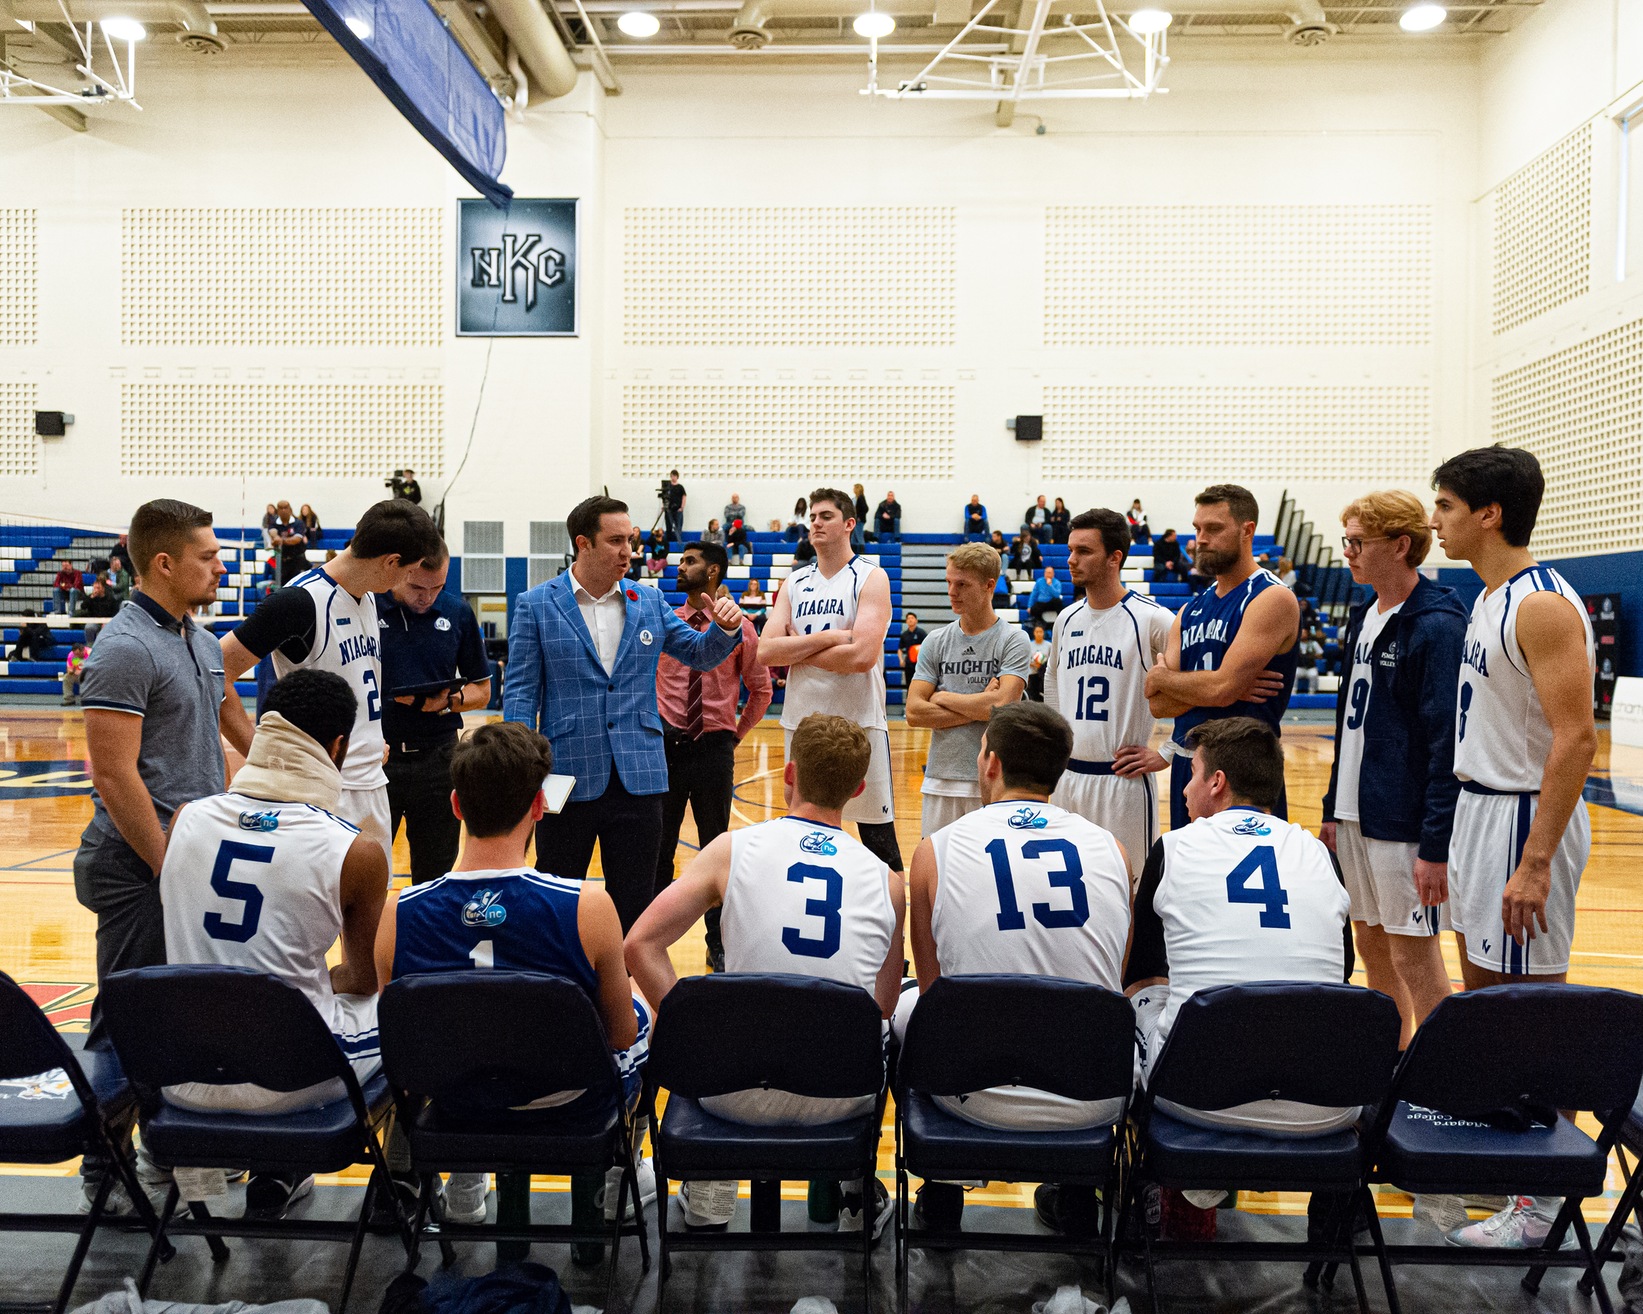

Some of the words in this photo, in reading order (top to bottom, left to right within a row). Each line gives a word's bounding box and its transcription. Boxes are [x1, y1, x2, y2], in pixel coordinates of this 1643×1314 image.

[470, 234, 566, 312] NKC
[795, 598, 845, 619] NIAGARA
[938, 658, 1000, 677] KNIGHTS
[1066, 644, 1124, 670] NIAGARA
[362, 669, 381, 722] 2
[1075, 676, 1110, 722] 12
[1346, 678, 1371, 730] 9
[203, 839, 276, 943] 5
[781, 861, 843, 960] 3
[984, 838, 1090, 932] 13
[1225, 845, 1292, 929] 4
[1406, 1113, 1453, 1121] College
[1433, 1119, 1491, 1128] Niagara
